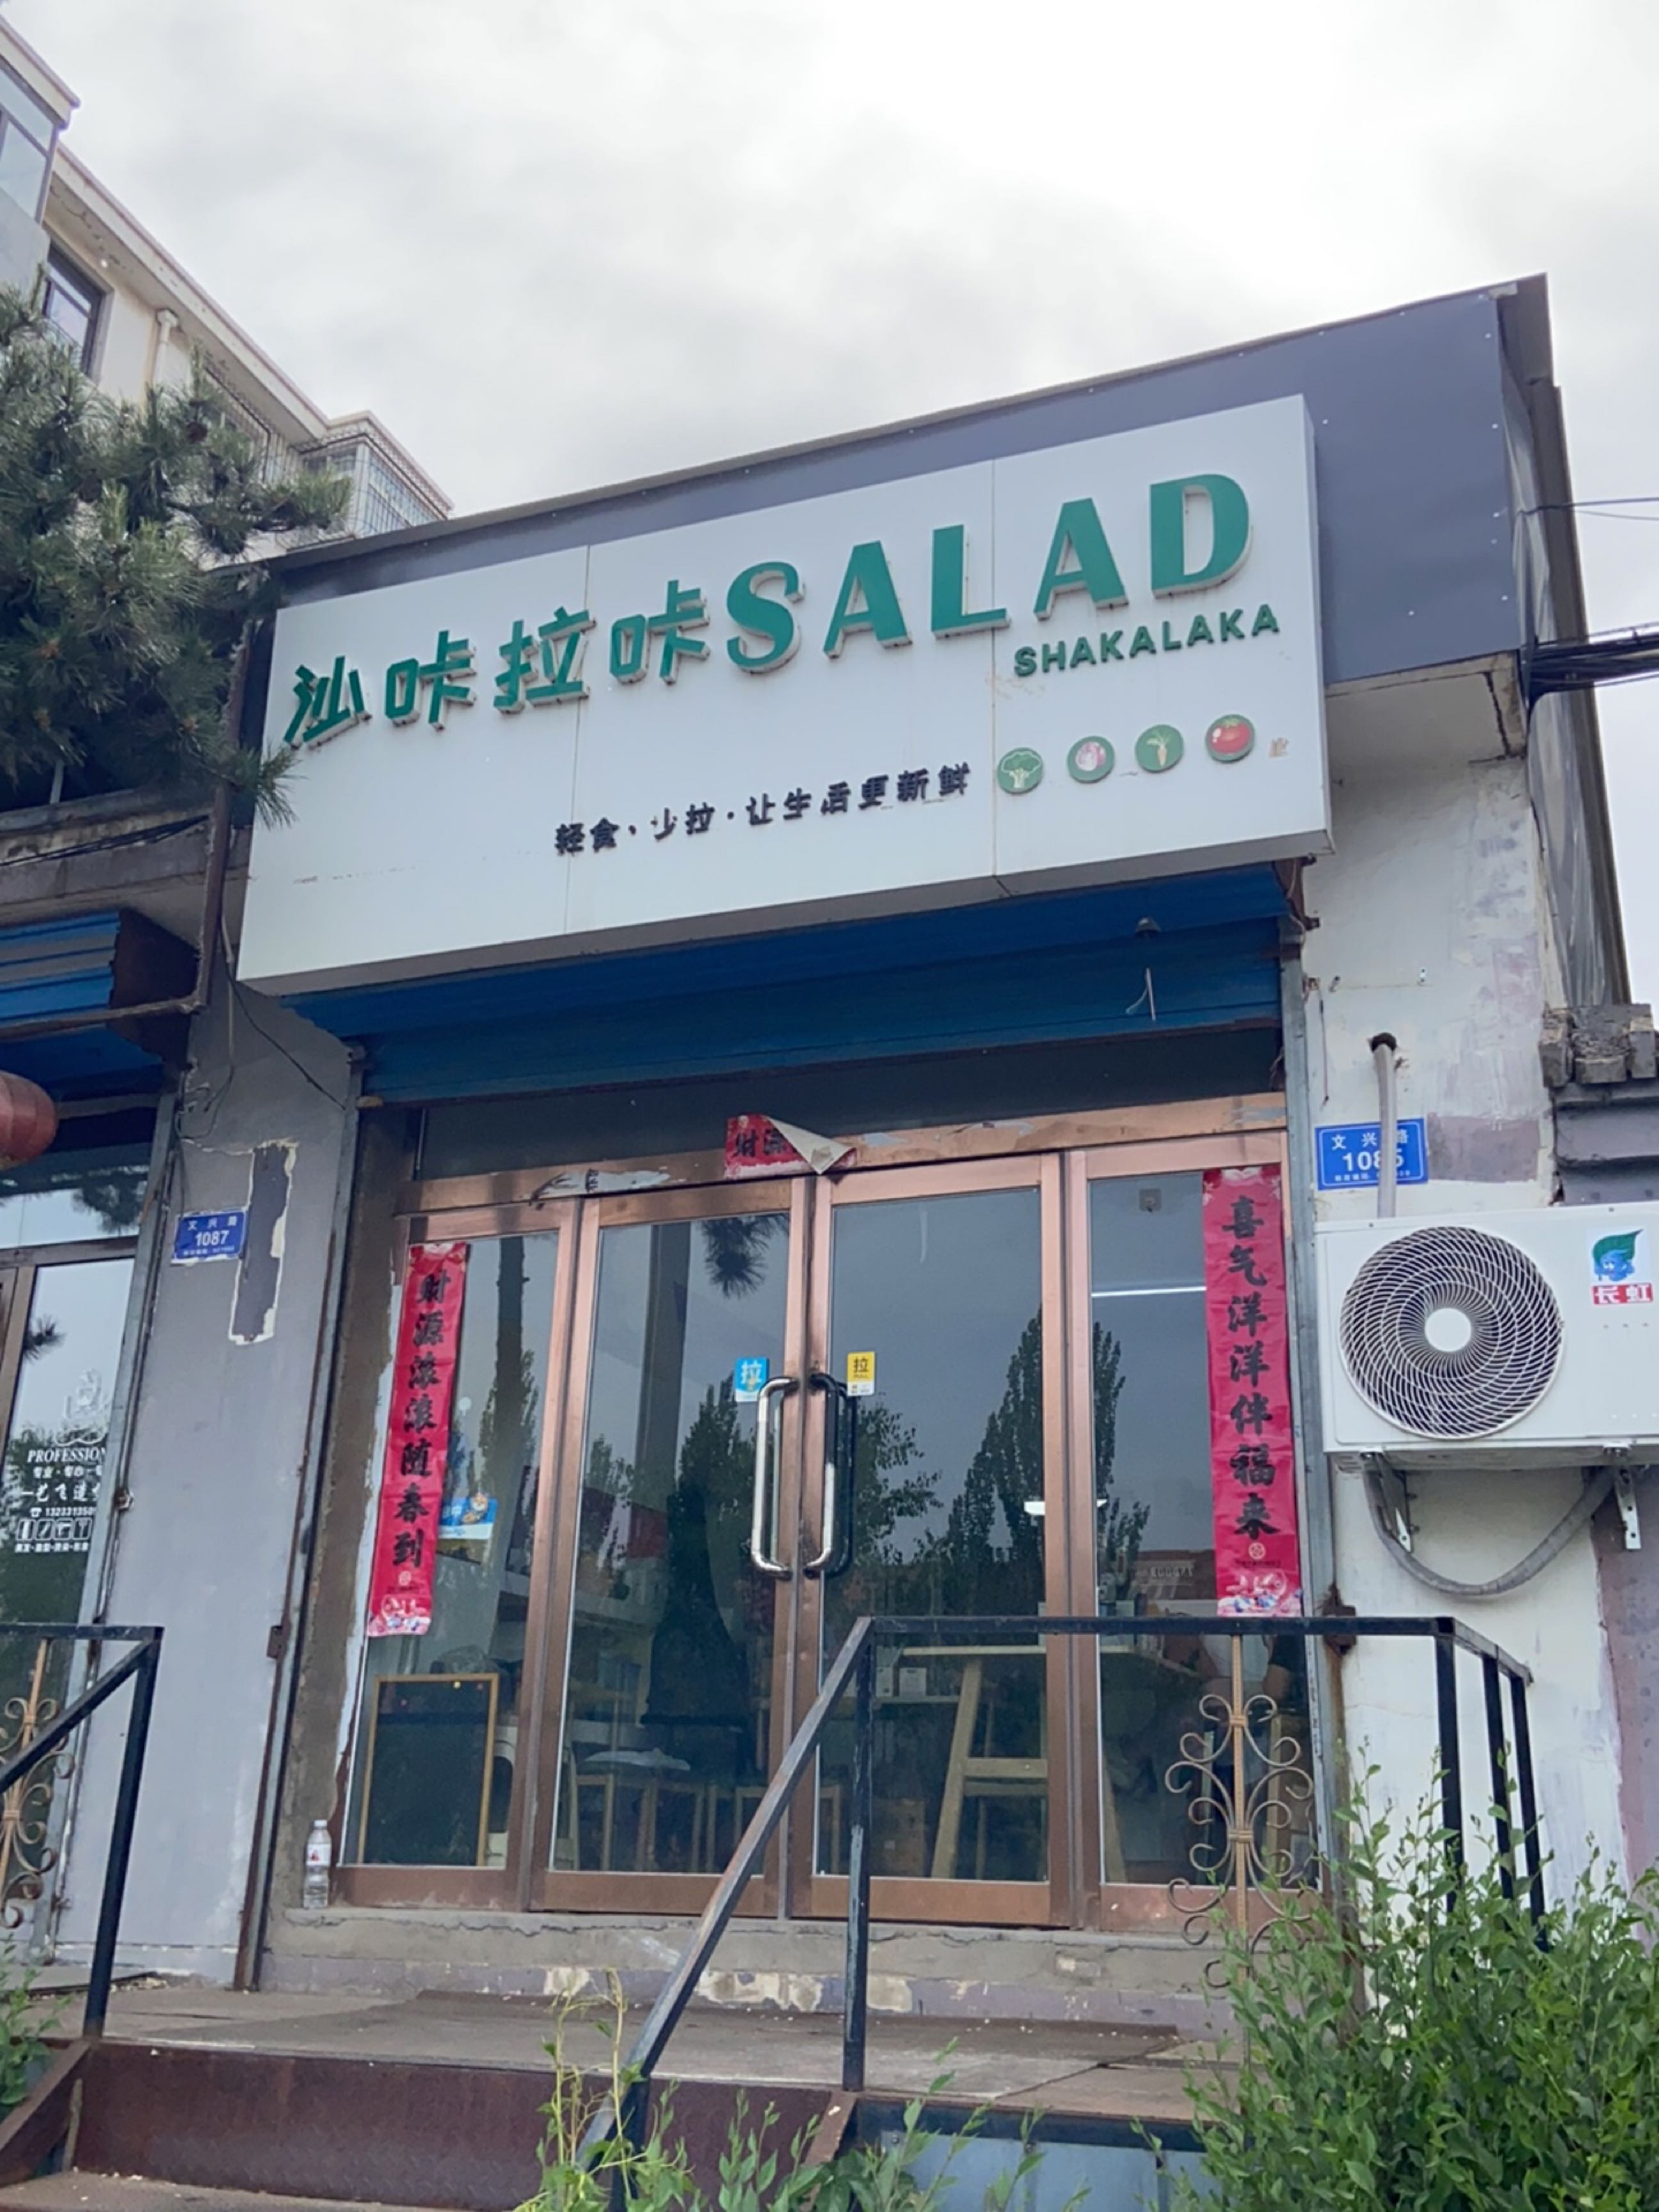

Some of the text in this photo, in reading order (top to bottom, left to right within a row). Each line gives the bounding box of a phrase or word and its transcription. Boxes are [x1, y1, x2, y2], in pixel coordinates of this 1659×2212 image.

[726, 474, 1249, 671] SALAD
[1014, 604, 1279, 677] SHAKALAKA
[195, 1230, 230, 1247] 1087
[1594, 1284, 1651, 1303] 长虹
[741, 1359, 762, 1385] 拉
[853, 1356, 869, 1374] 拉
[1221, 1194, 1279, 1541] 喜气洋洋伴福来
[392, 1269, 452, 1567] 财源滚滚随春到
